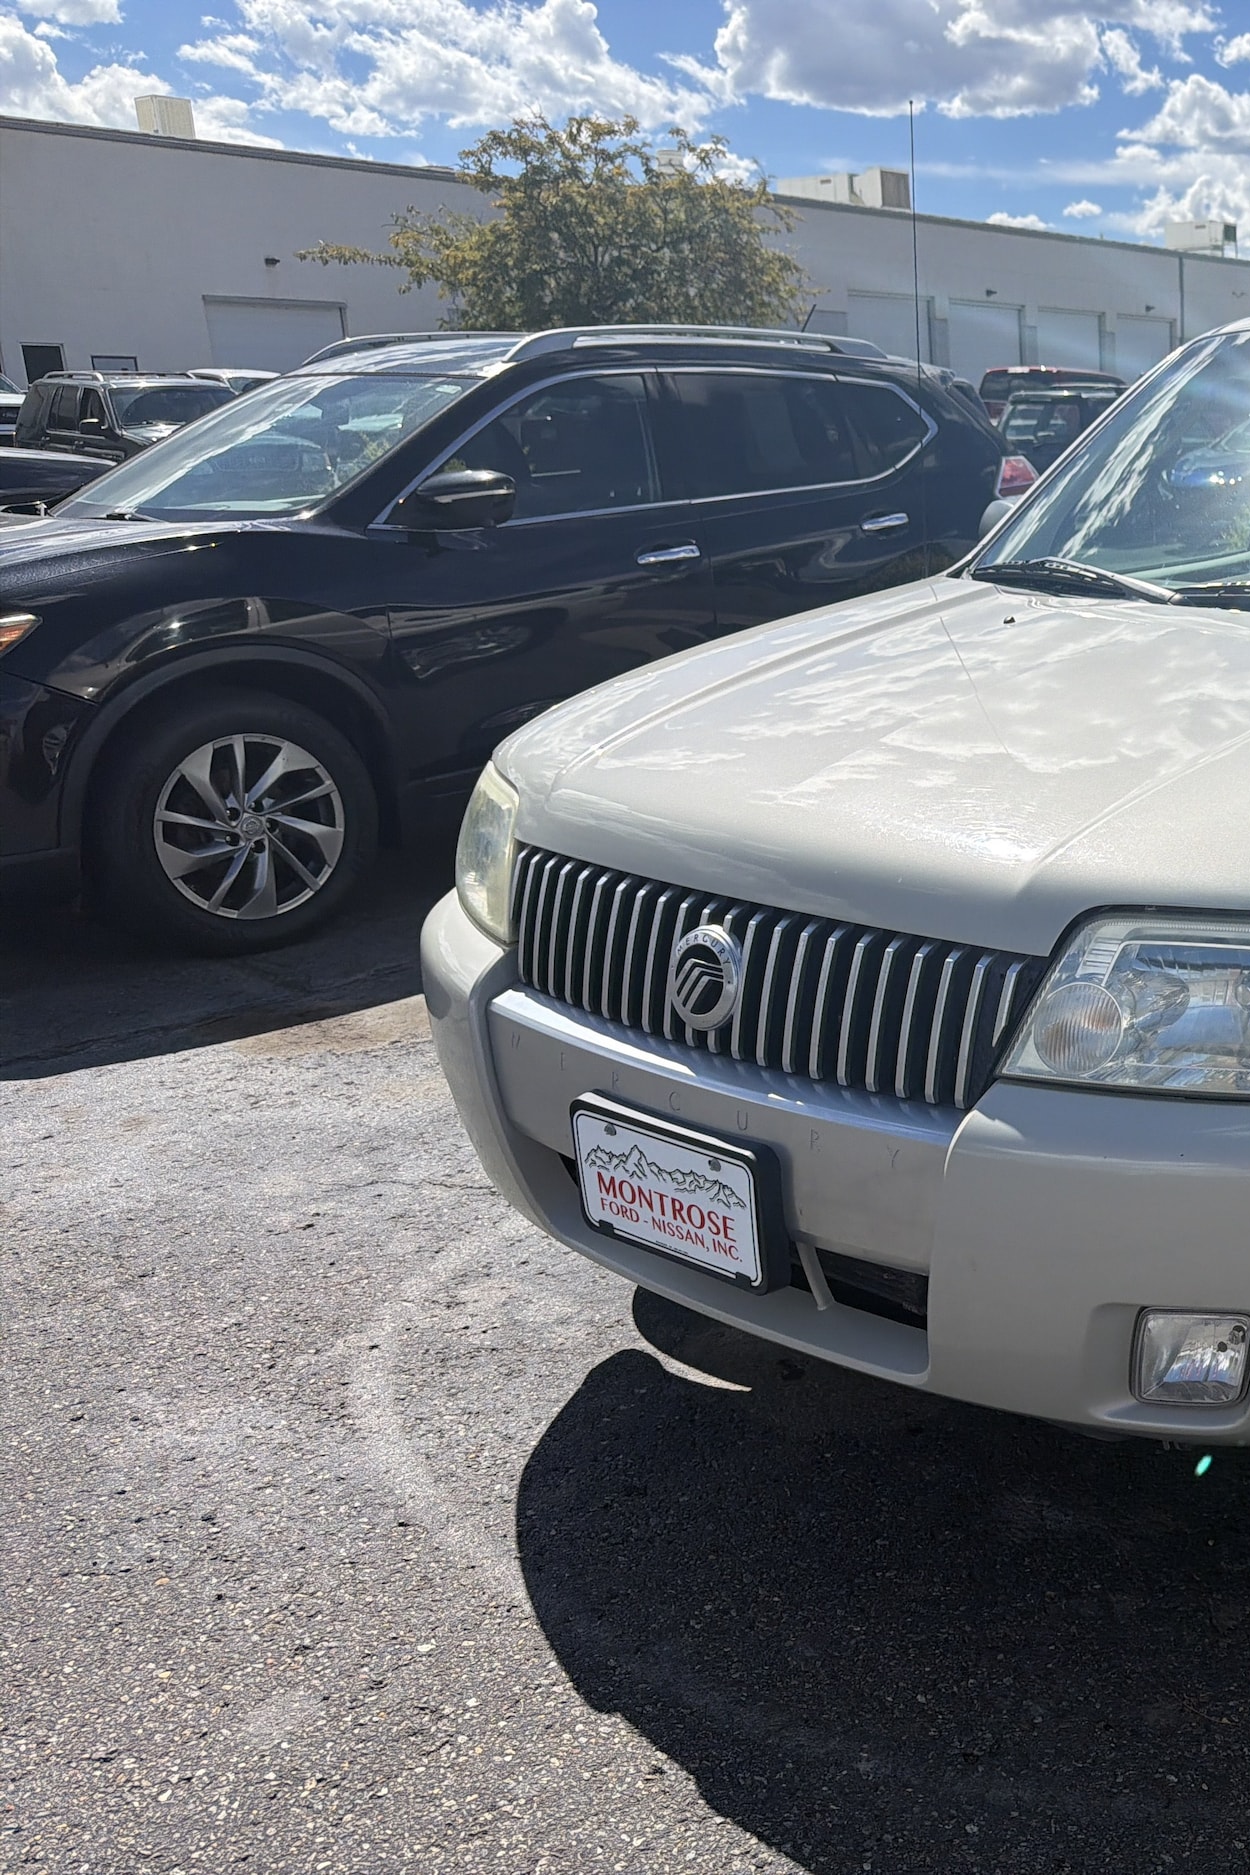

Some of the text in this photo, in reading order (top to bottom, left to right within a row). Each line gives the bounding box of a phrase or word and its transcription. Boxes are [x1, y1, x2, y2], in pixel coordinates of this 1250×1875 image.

[677, 933, 731, 965] MERCURY
[511, 1031, 900, 1168] MERCURY
[597, 1171, 737, 1243] MONTROSE
[600, 1197, 640, 1224] FORD
[652, 1215, 710, 1252] NISSAN,
[712, 1238, 743, 1263] INC.
